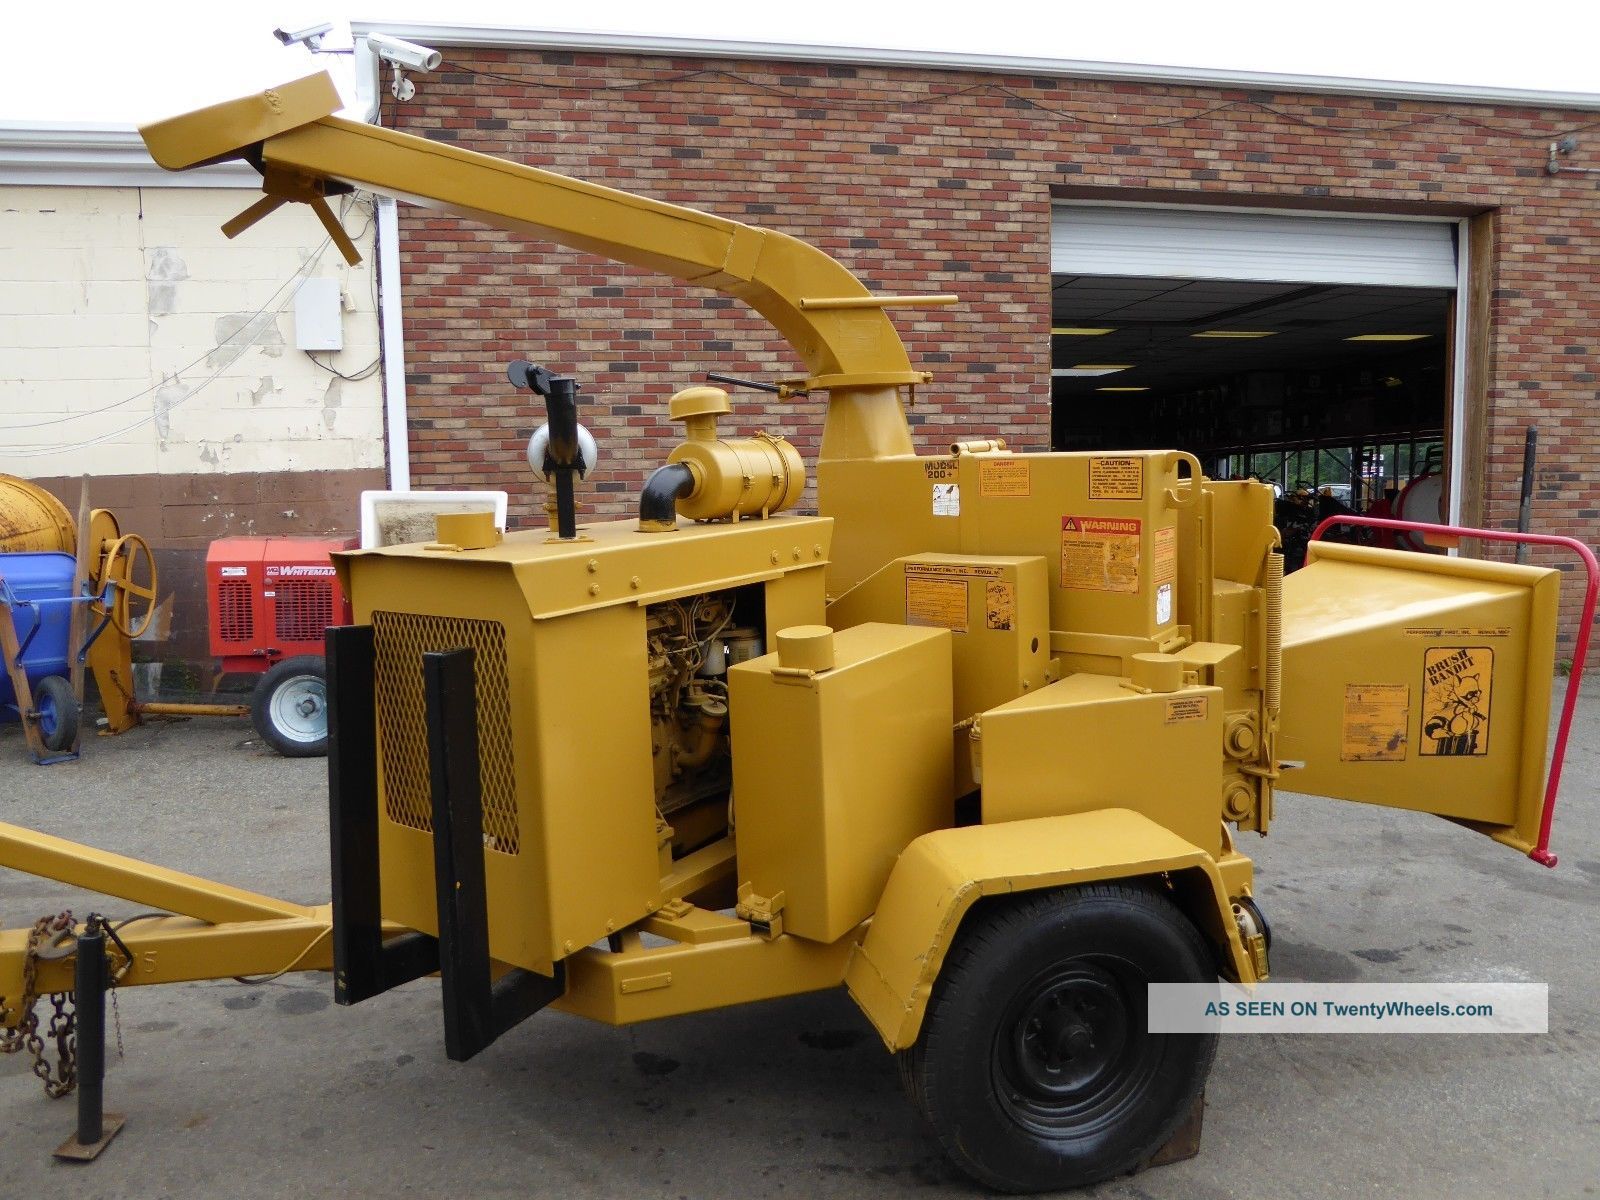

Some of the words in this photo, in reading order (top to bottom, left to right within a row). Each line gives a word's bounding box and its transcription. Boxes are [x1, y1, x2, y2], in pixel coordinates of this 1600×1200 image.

[1080, 520, 1137, 532] WARNING
[280, 566, 337, 576] WHITEMAN
[1426, 648, 1469, 677] BRUSH
[1429, 656, 1475, 686] BANDIT
